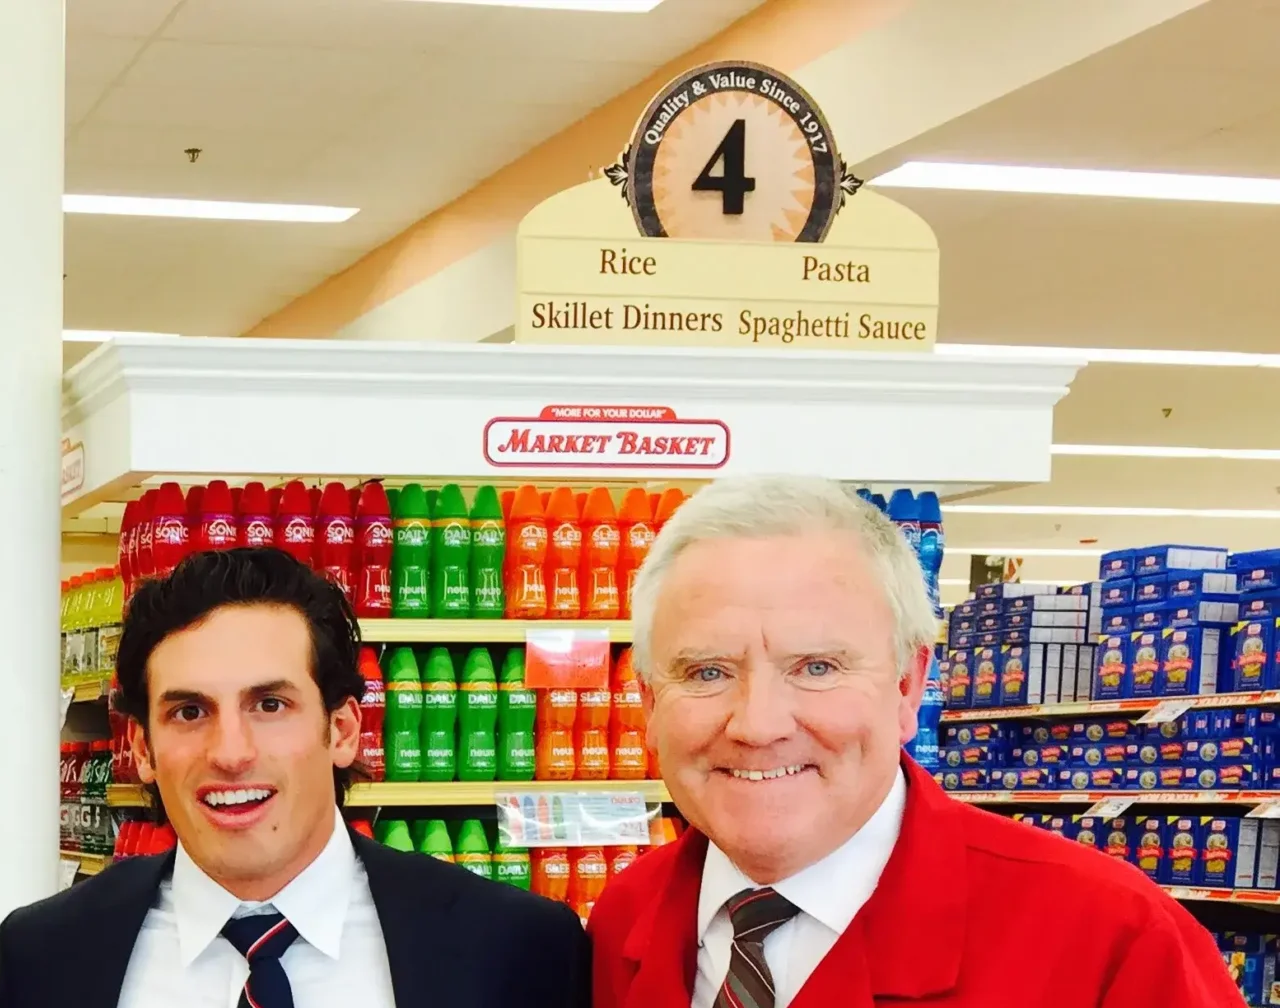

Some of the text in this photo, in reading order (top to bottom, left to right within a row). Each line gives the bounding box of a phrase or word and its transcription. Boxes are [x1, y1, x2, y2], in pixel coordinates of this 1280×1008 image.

[644, 72, 828, 154] Quality & Value Since 1917
[692, 118, 756, 215] 4
[600, 248, 658, 277] Rice
[803, 256, 871, 284] Pasta
[532, 302, 725, 333] Skillet Dinners
[738, 309, 927, 346] Spaghetti Sauce
[583, 409, 601, 418] FOR
[602, 409, 628, 418] YOUR
[155, 526, 189, 538] SONIC
[398, 530, 428, 541] DAILY
[474, 531, 504, 541] DAILY
[426, 694, 456, 704] DAILY
[498, 865, 528, 875] DAILY
